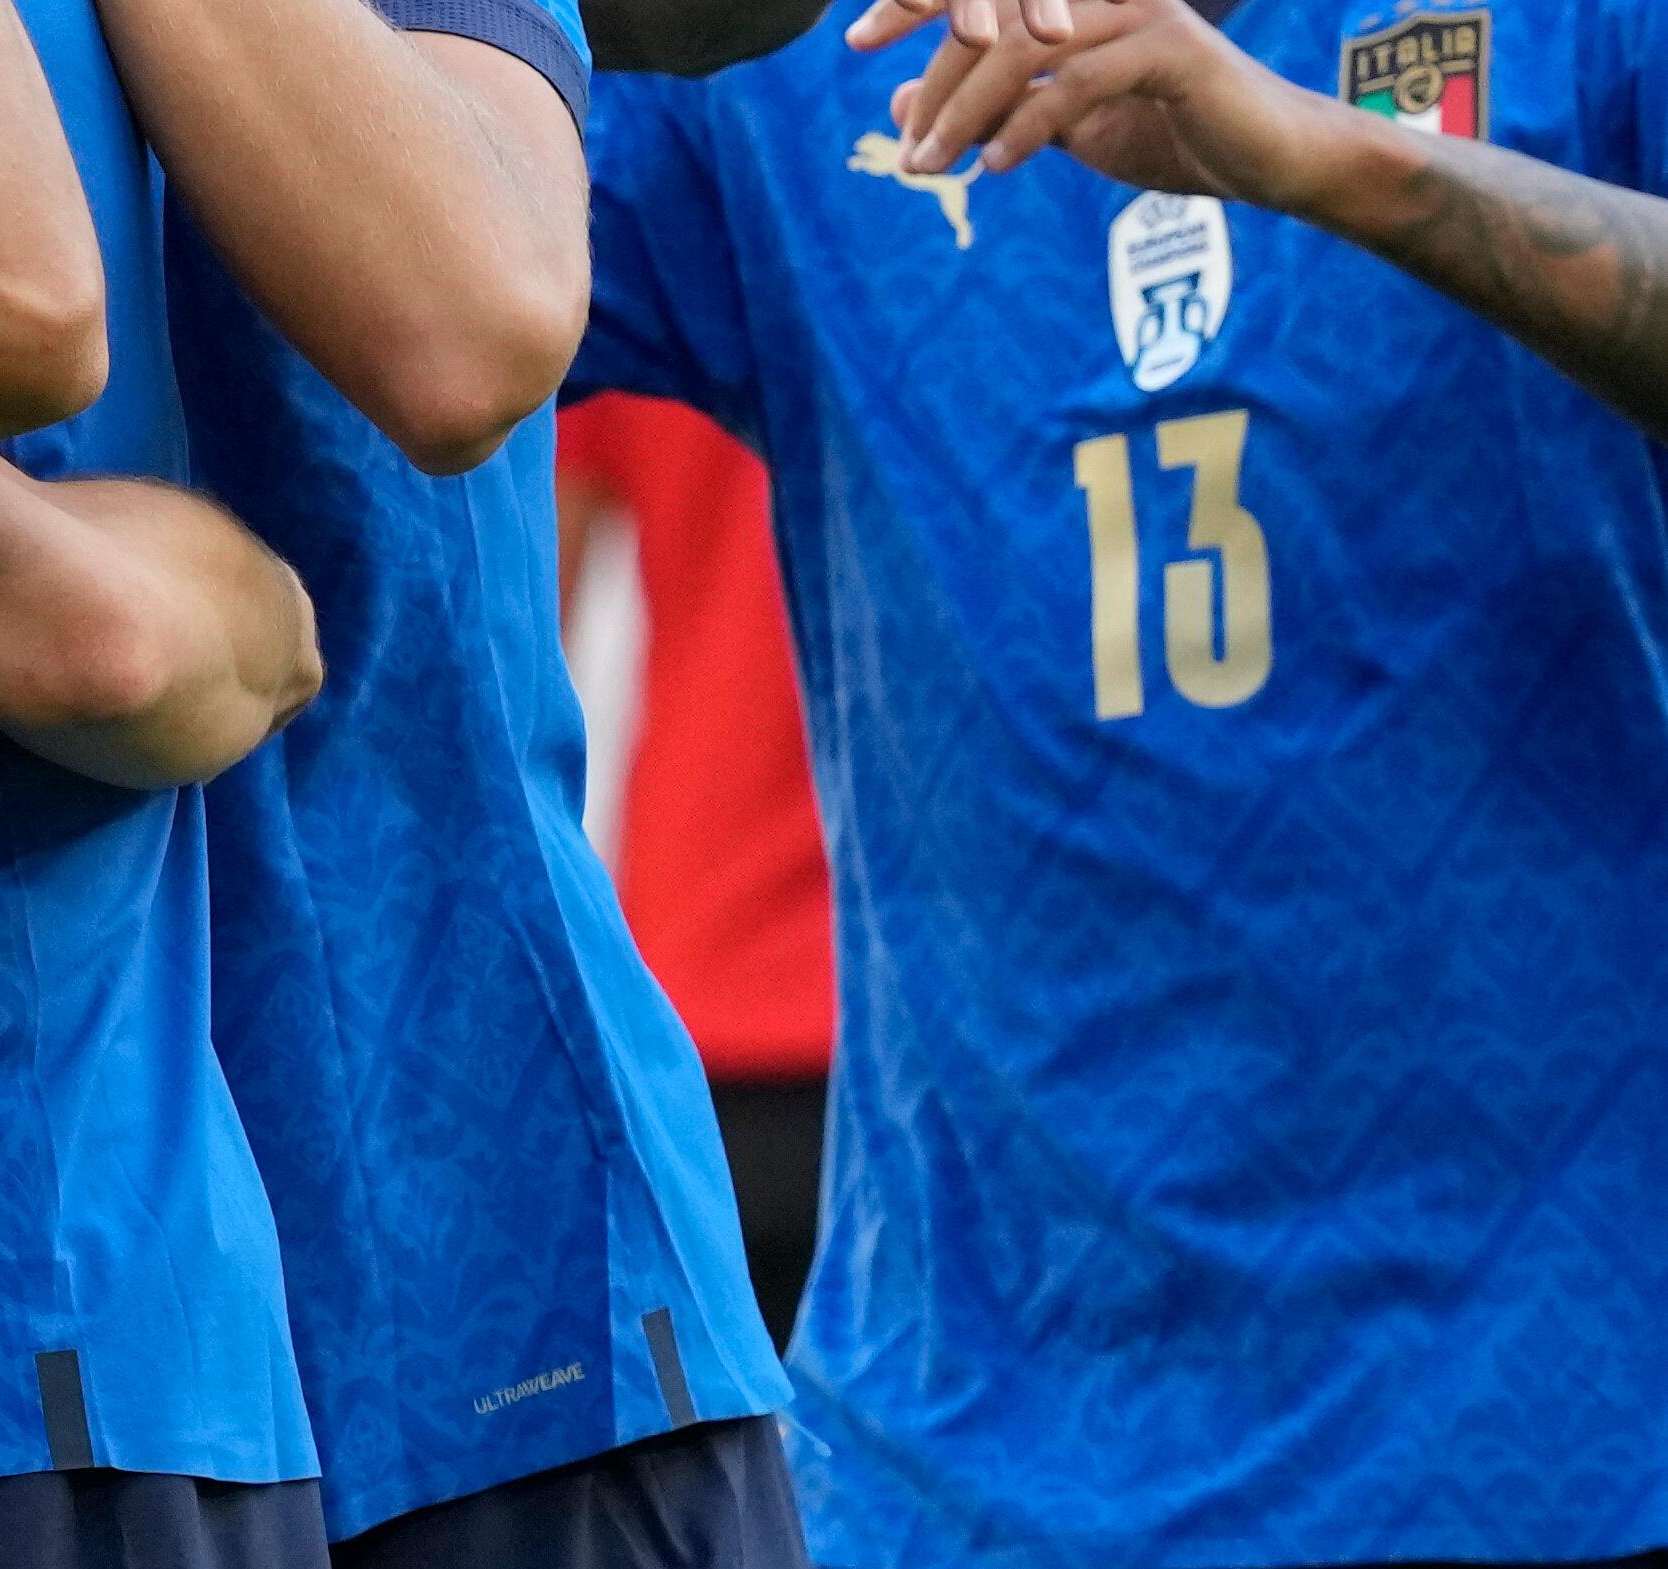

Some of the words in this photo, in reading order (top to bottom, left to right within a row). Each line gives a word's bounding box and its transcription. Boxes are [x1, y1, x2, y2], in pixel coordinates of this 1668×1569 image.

[1356, 26, 1477, 82] ITALIA
[1072, 407, 1273, 721] 13
[472, 1361, 586, 1415] ULTRAWEAVE
